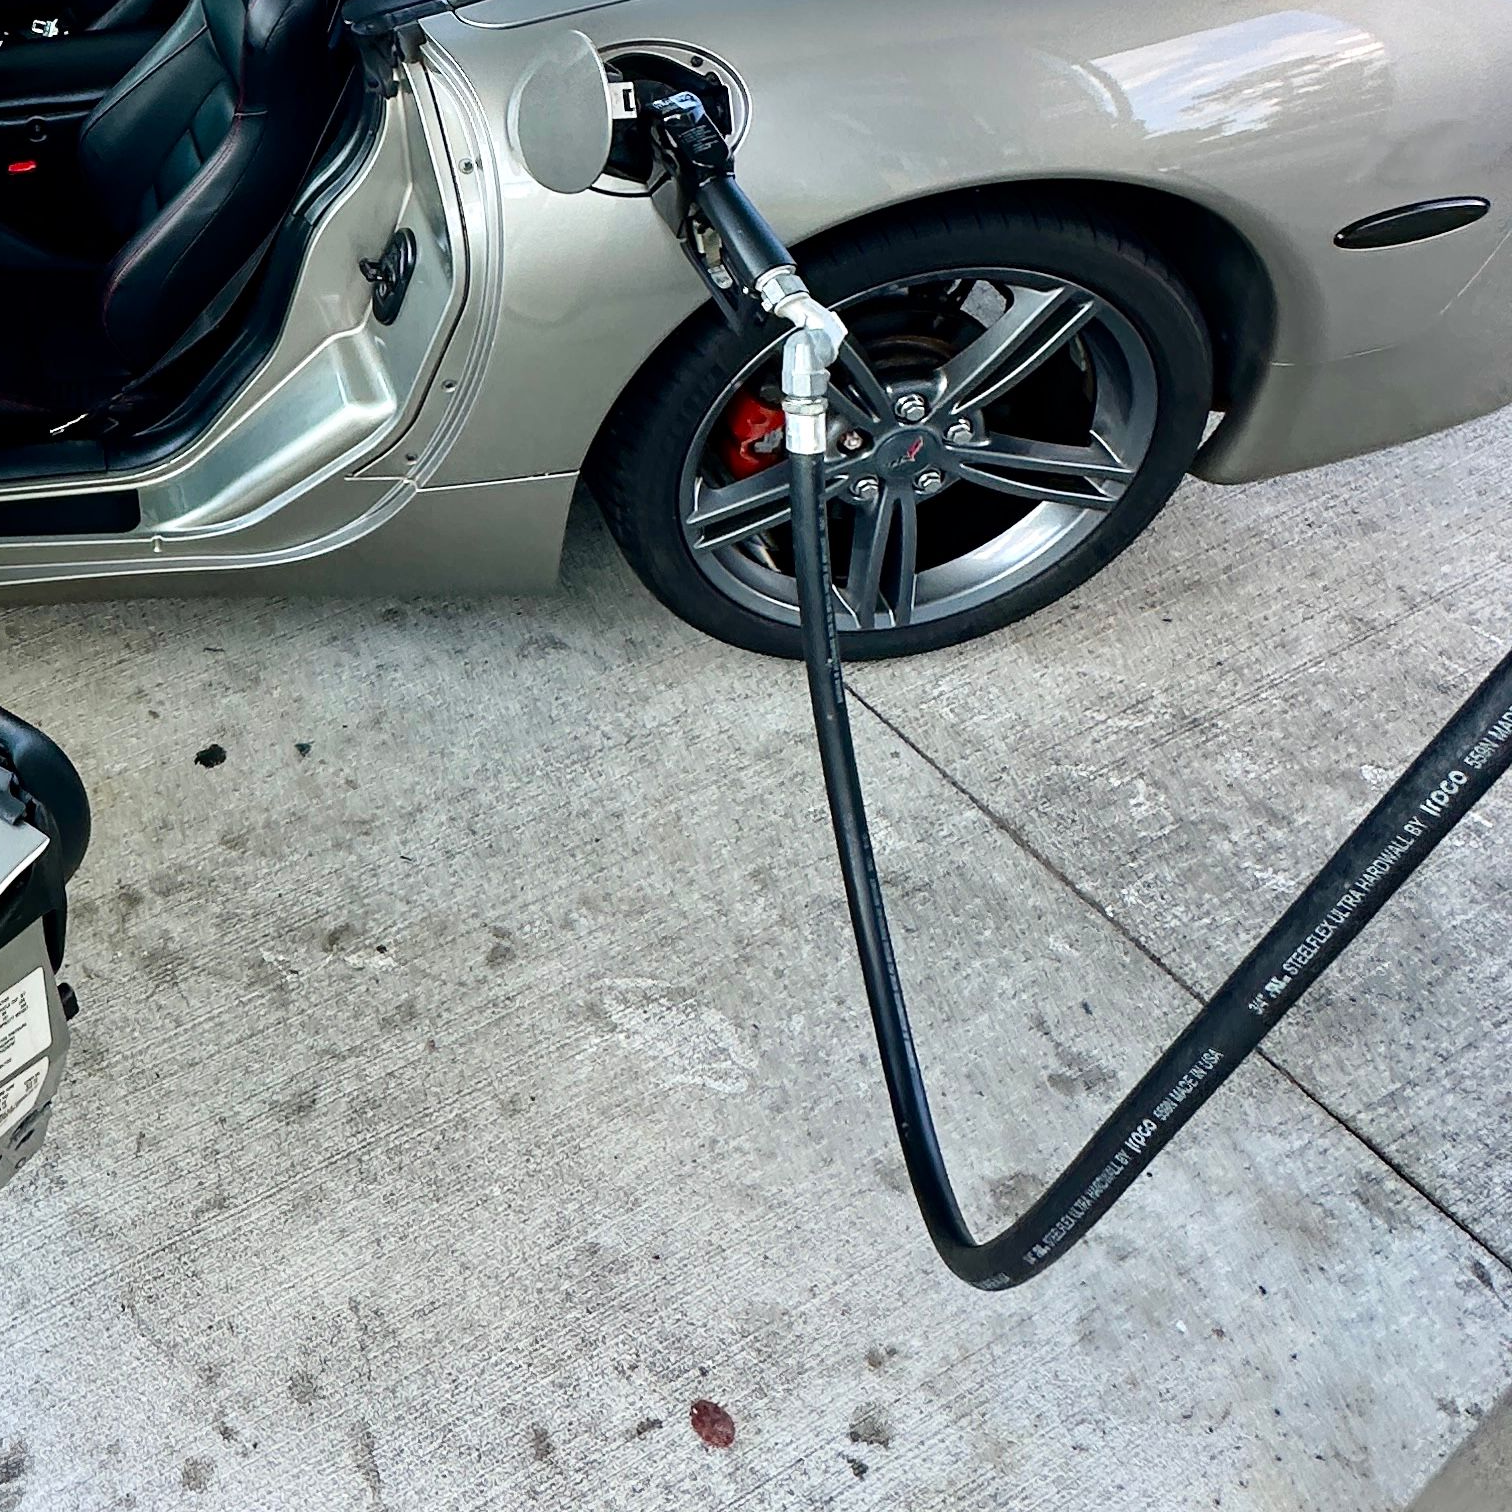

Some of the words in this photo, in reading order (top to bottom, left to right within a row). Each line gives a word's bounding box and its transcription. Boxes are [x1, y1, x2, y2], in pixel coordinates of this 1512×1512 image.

[1282, 915, 1338, 976] STEELFLEX
[1329, 885, 1367, 924] ULTRA
[1355, 836, 1415, 893] HARDWALL
[1403, 816, 1428, 837] BY
[1488, 705, 1512, 742] MAD
[1189, 1060, 1208, 1080] IN
[1200, 1048, 1225, 1070] USA
